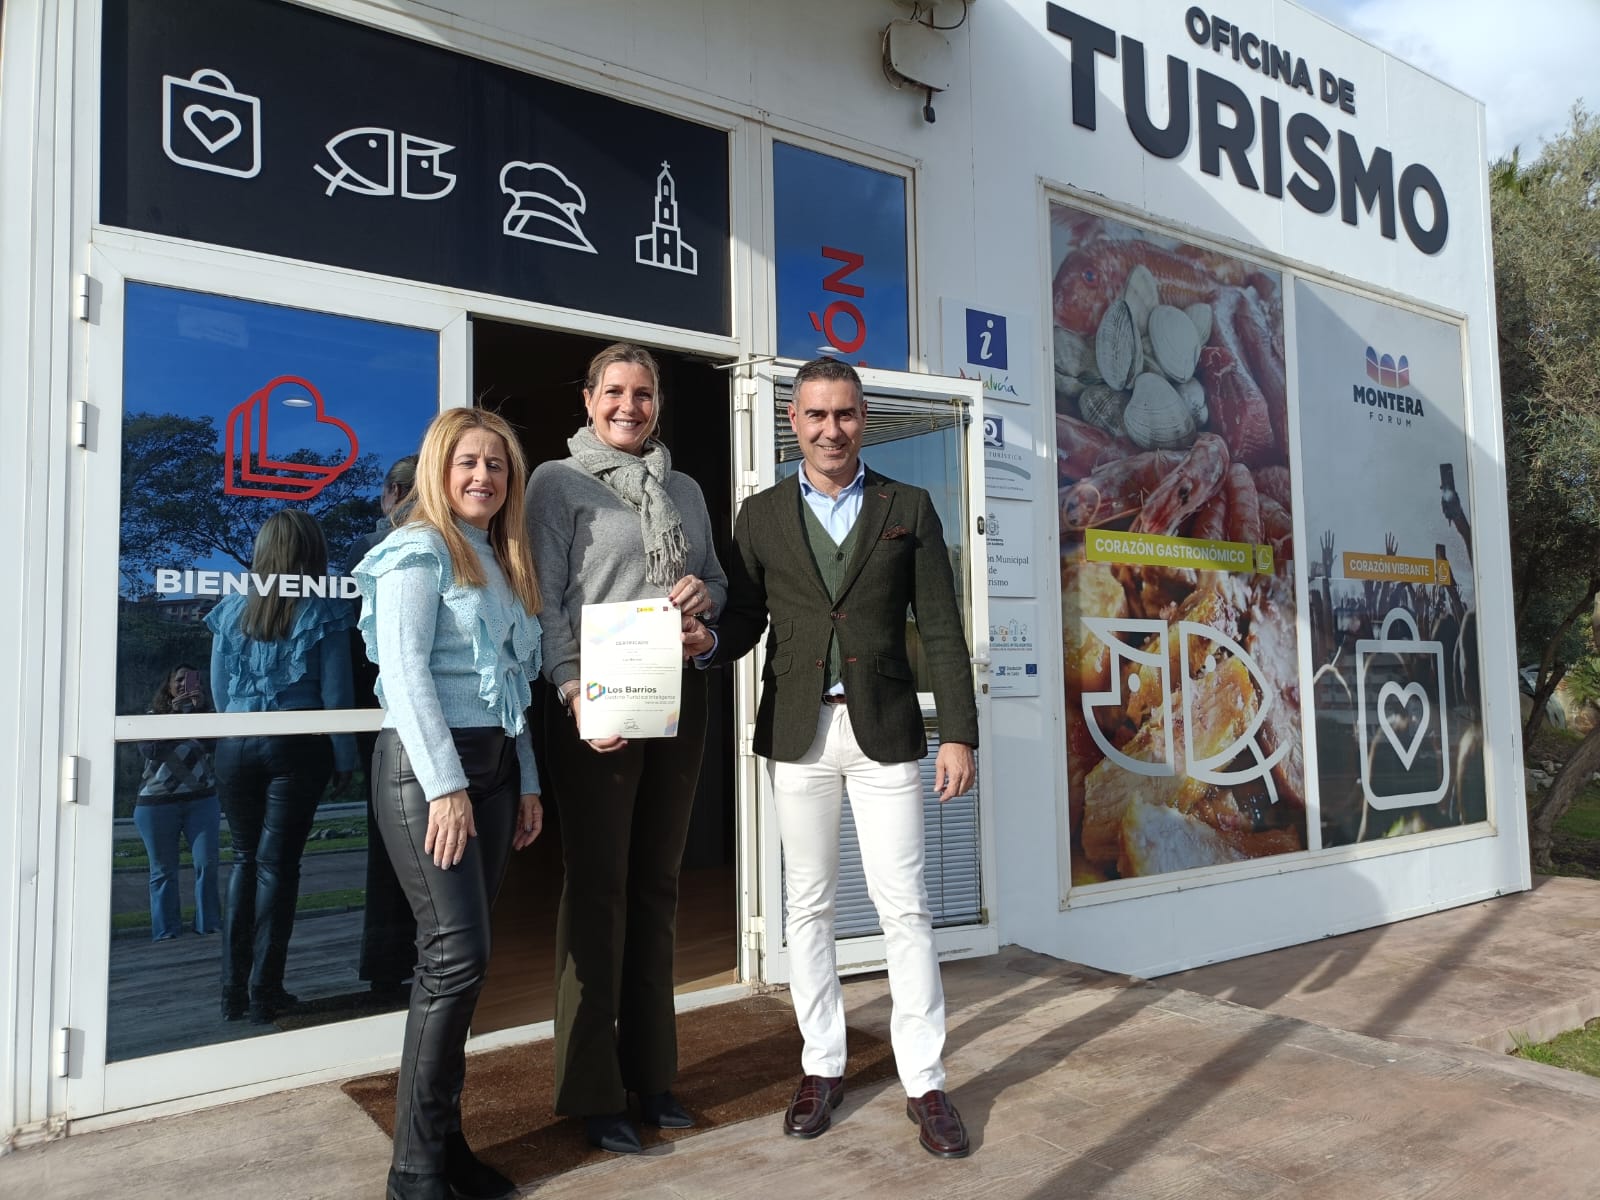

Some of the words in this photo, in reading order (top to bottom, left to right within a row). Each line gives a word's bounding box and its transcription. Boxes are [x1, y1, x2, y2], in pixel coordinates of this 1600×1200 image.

[1185, 6, 1314, 95] OFICINA
[1319, 68, 1356, 114] DE
[1046, 1, 1449, 256] TURISMO
[808, 246, 867, 367] ÓN
[1353, 384, 1424, 417] MONTERA
[1369, 411, 1412, 428] FORUM
[996, 555, 1029, 566] Municipal
[1095, 537, 1154, 557] CORAZÓN
[1156, 542, 1246, 564] GASTRONÓMICO
[988, 566, 998, 574] de
[1349, 558, 1390, 575] CORAZÓN
[1391, 560, 1430, 577] VIBRANTE
[157, 569, 362, 599] BIENVENID
[988, 579, 1009, 587] rismo
[607, 686, 623, 694] Los
[625, 685, 657, 694] Barrios
